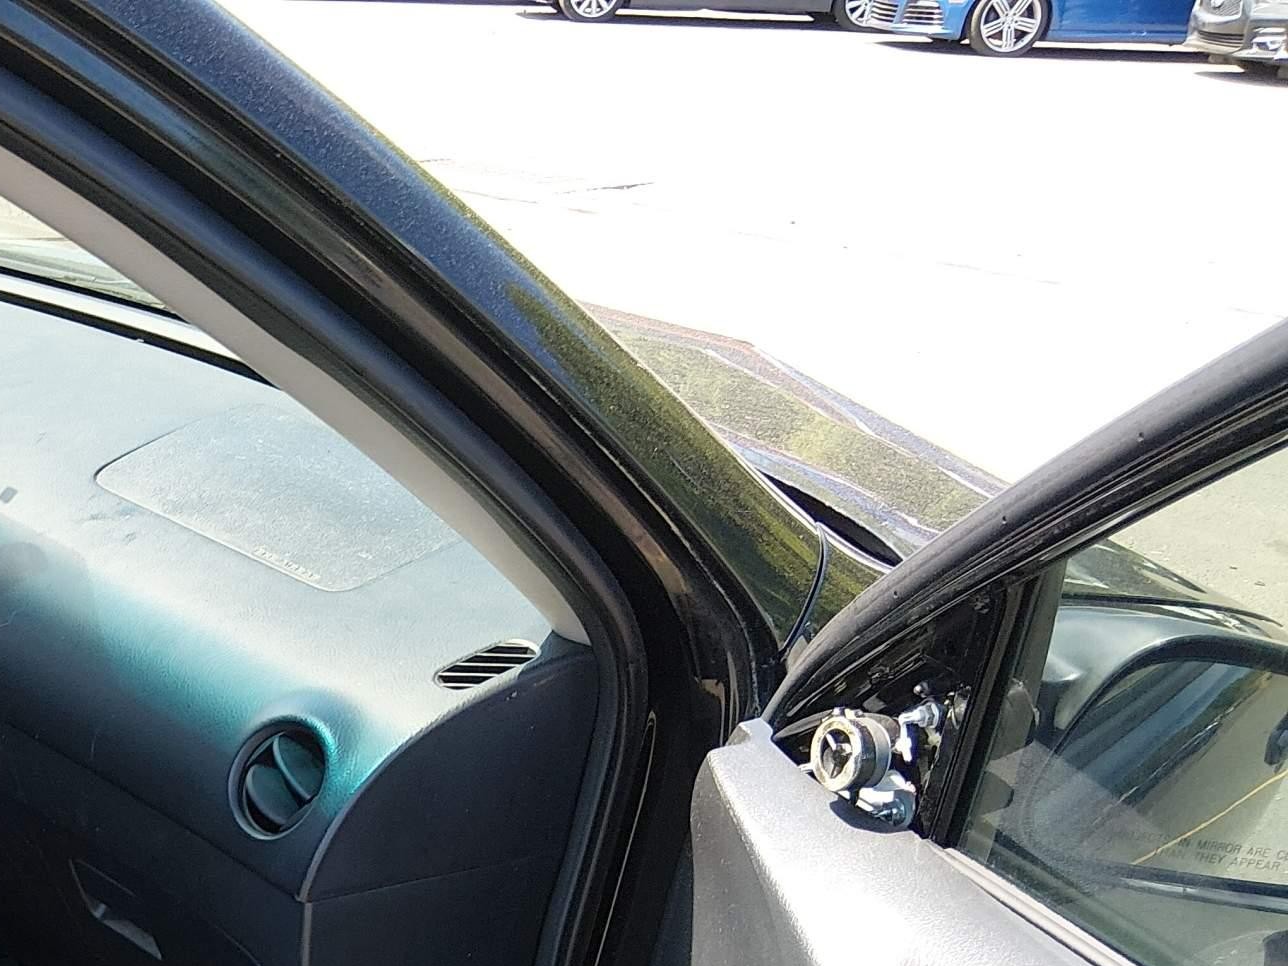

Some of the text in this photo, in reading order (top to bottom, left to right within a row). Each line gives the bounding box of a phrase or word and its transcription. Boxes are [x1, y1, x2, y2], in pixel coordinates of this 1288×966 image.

[1197, 839, 1242, 854] MIRROR
[1246, 847, 1272, 858] ARE
[1196, 852, 1227, 865] THEY
[1229, 857, 1281, 872] APPEAR
